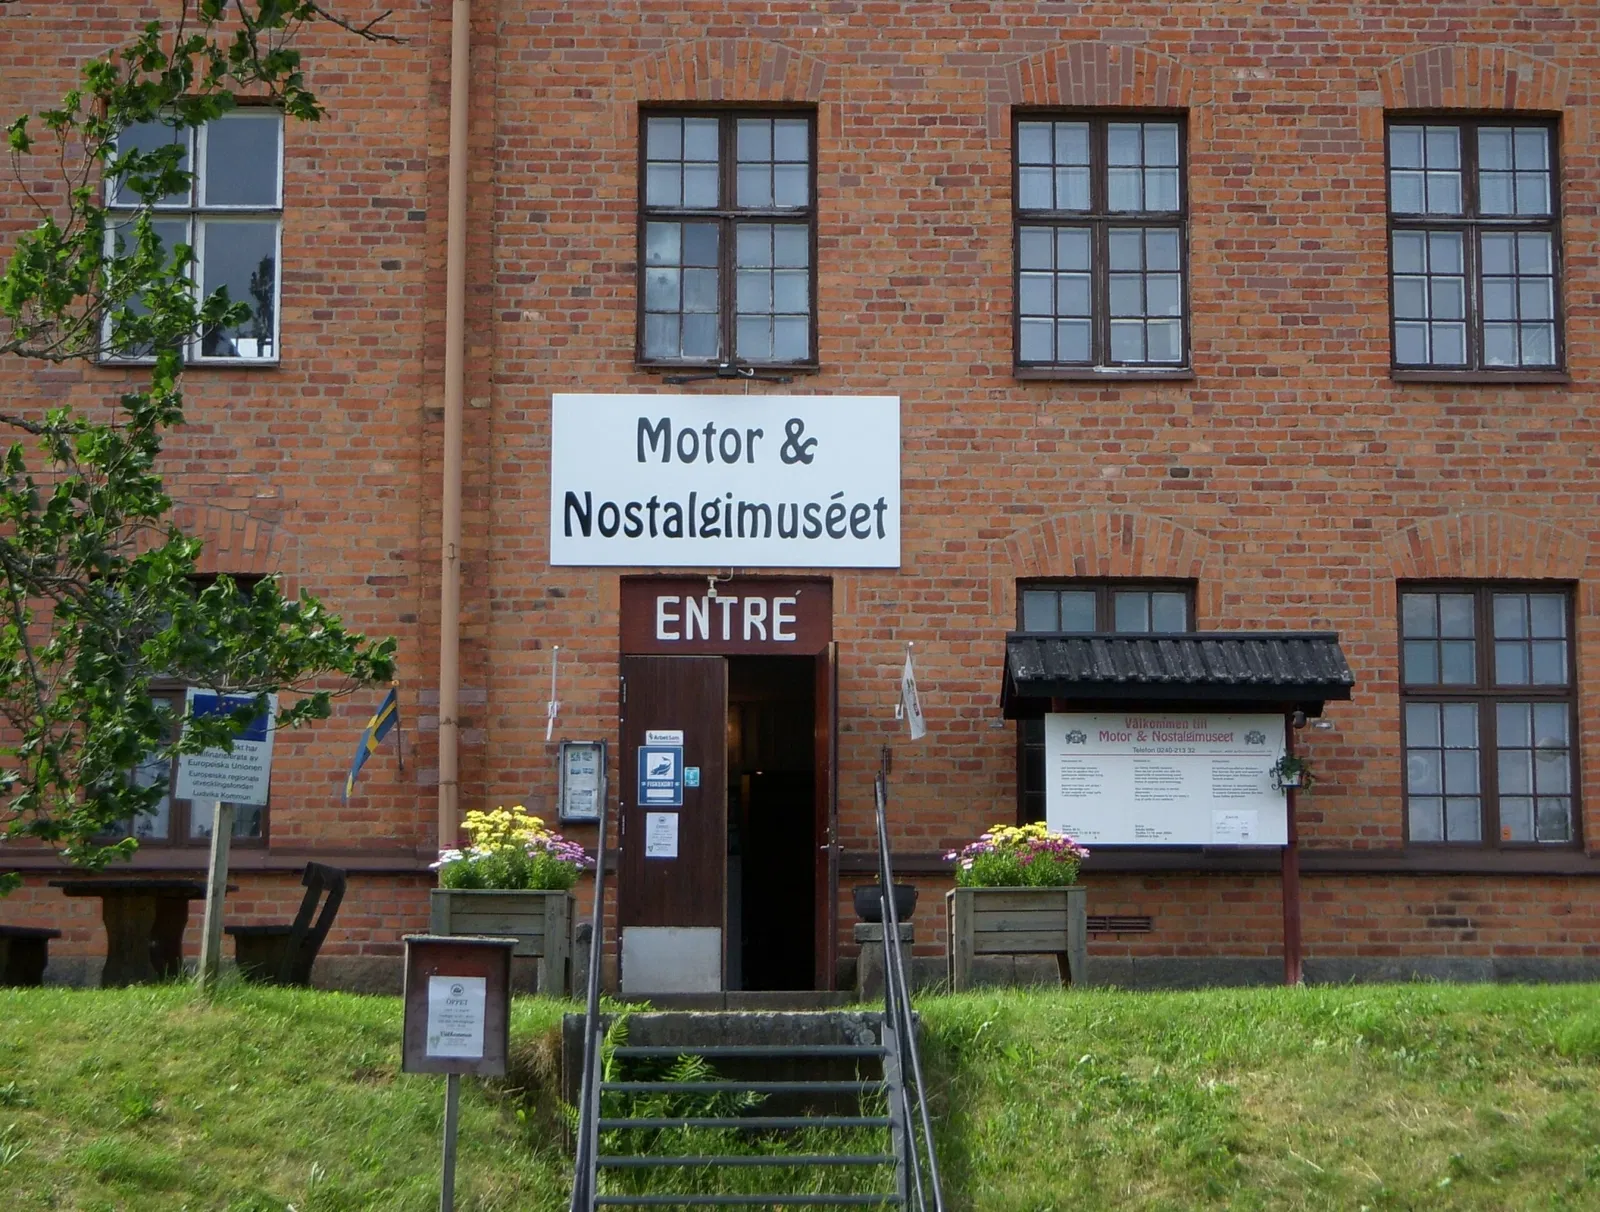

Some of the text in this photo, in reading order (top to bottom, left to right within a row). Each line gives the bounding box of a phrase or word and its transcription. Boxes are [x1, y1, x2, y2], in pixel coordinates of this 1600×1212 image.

[636, 417, 818, 465] Motor &
[564, 490, 888, 540] Nostalgimuséet
[656, 589, 802, 641] ENTRÉ
[1099, 730, 1234, 743] Motor & Nostalgimuseet
[1132, 746, 1156, 754] Telefon
[188, 758, 263, 772] Europeiska Unionen
[188, 771, 226, 779] Europeiska
[193, 790, 251, 800] Ludvika Kommun
